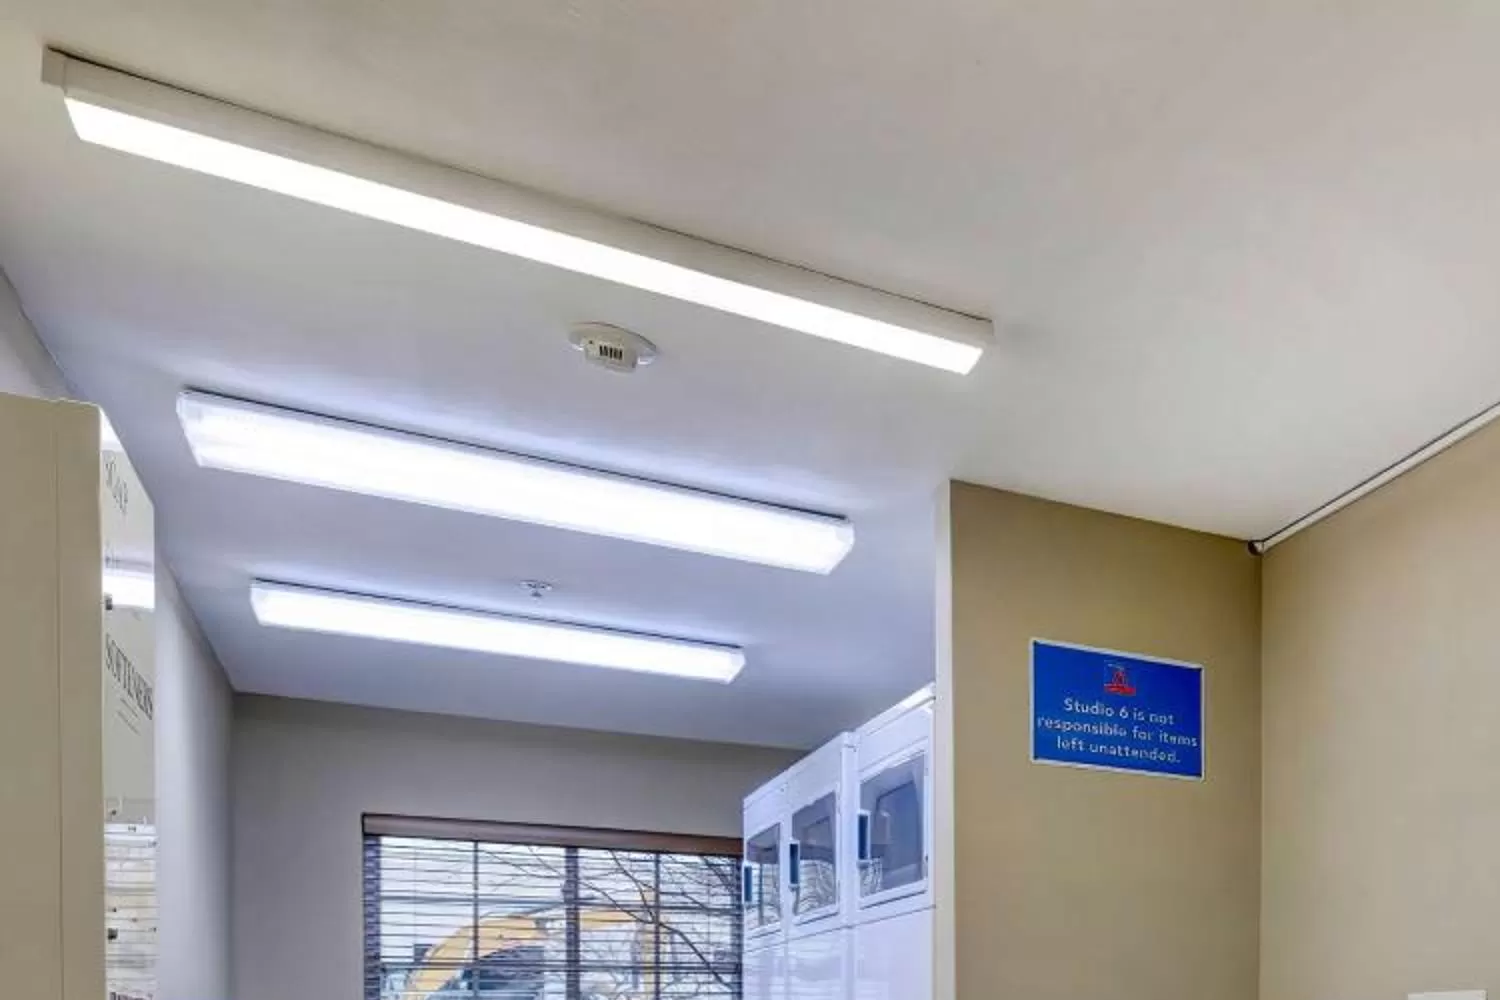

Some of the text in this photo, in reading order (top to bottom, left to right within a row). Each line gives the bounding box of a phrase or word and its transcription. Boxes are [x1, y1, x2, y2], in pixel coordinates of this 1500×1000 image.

[1063, 697, 1175, 726] Studio 6 is not
[1037, 715, 1198, 747] responsible for items
[1057, 735, 1182, 764] left unattended.
